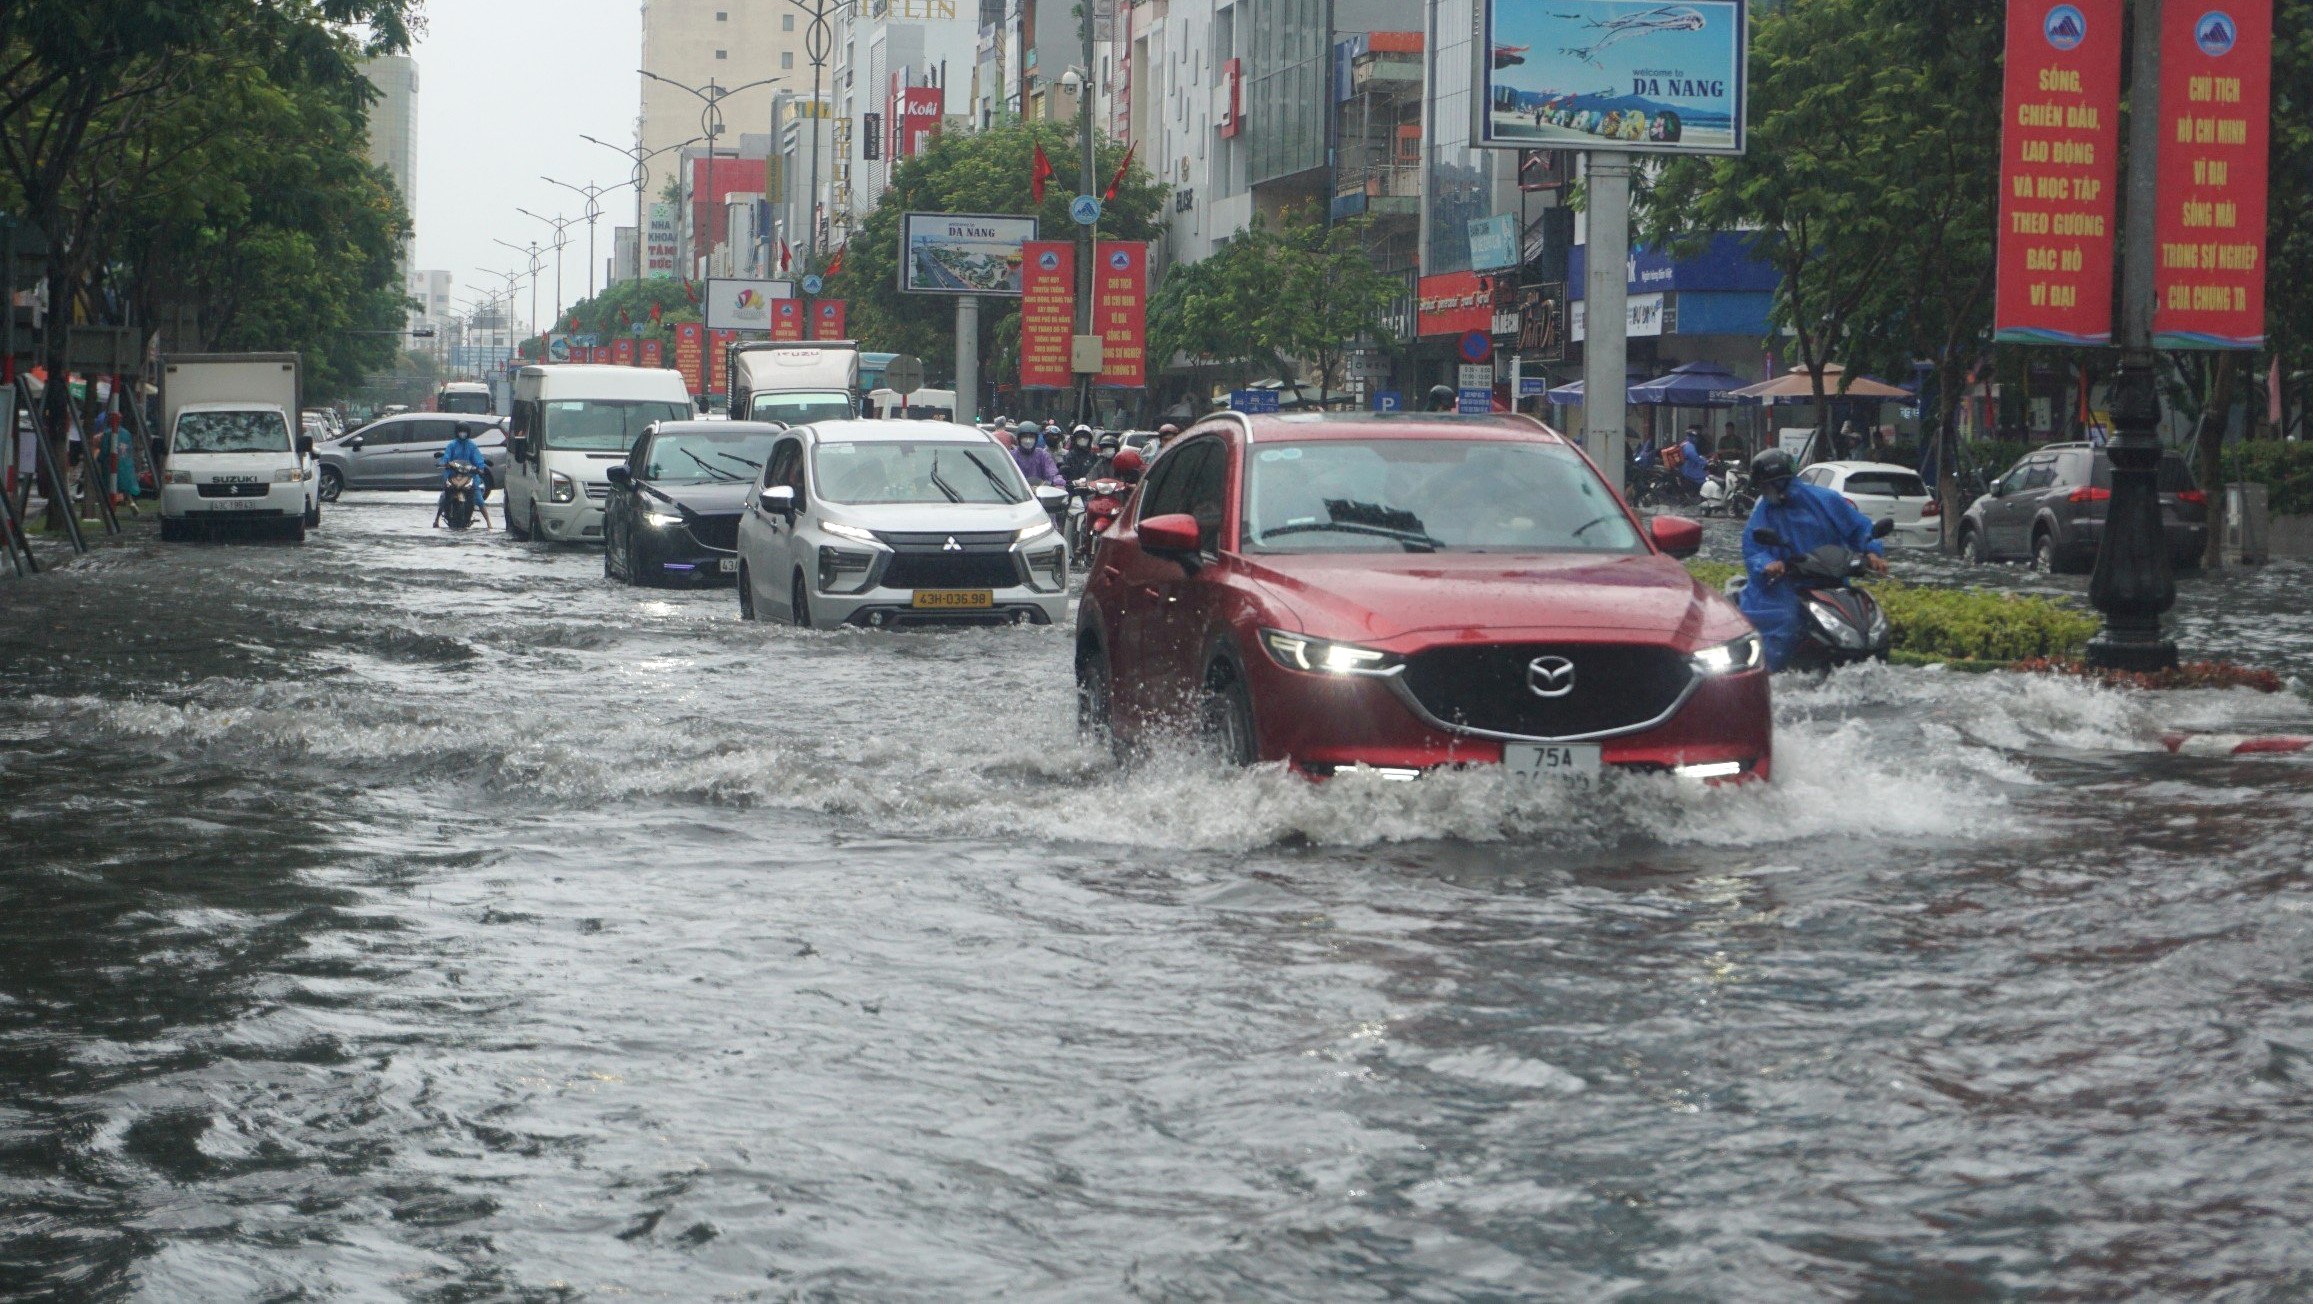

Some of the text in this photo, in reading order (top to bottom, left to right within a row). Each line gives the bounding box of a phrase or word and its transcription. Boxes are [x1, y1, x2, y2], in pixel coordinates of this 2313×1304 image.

[1632, 68, 1684, 77] welcome to
[1633, 78, 1723, 97] DA NANG
[2190, 71, 2240, 106] CHỦ TỊCH
[907, 101, 937, 116] Kohi
[2018, 98, 2062, 127] CHIẾN
[2177, 110, 2246, 144] HỒ CHÍ MINH
[2022, 138, 2094, 167] LAO ĐỘNG
[2194, 157, 2227, 190] VĨ ĐẠI
[2013, 173, 2101, 204] VÀ HỌC TẬP
[2012, 211, 2104, 237] THEO GƯƠNG
[2183, 194, 2236, 227] SỐNG MÃI
[949, 227, 995, 238] DA NANG
[2026, 244, 2082, 271] BÁC HỒ
[2163, 241, 2258, 274] TRONG SỰ NGHIỆP
[2030, 282, 2076, 310] VĨ ĐẠI
[2168, 280, 2246, 311] CỦA CHÚNG TA
[1382, 398, 1394, 411] P
[1533, 747, 1572, 768] 75A
